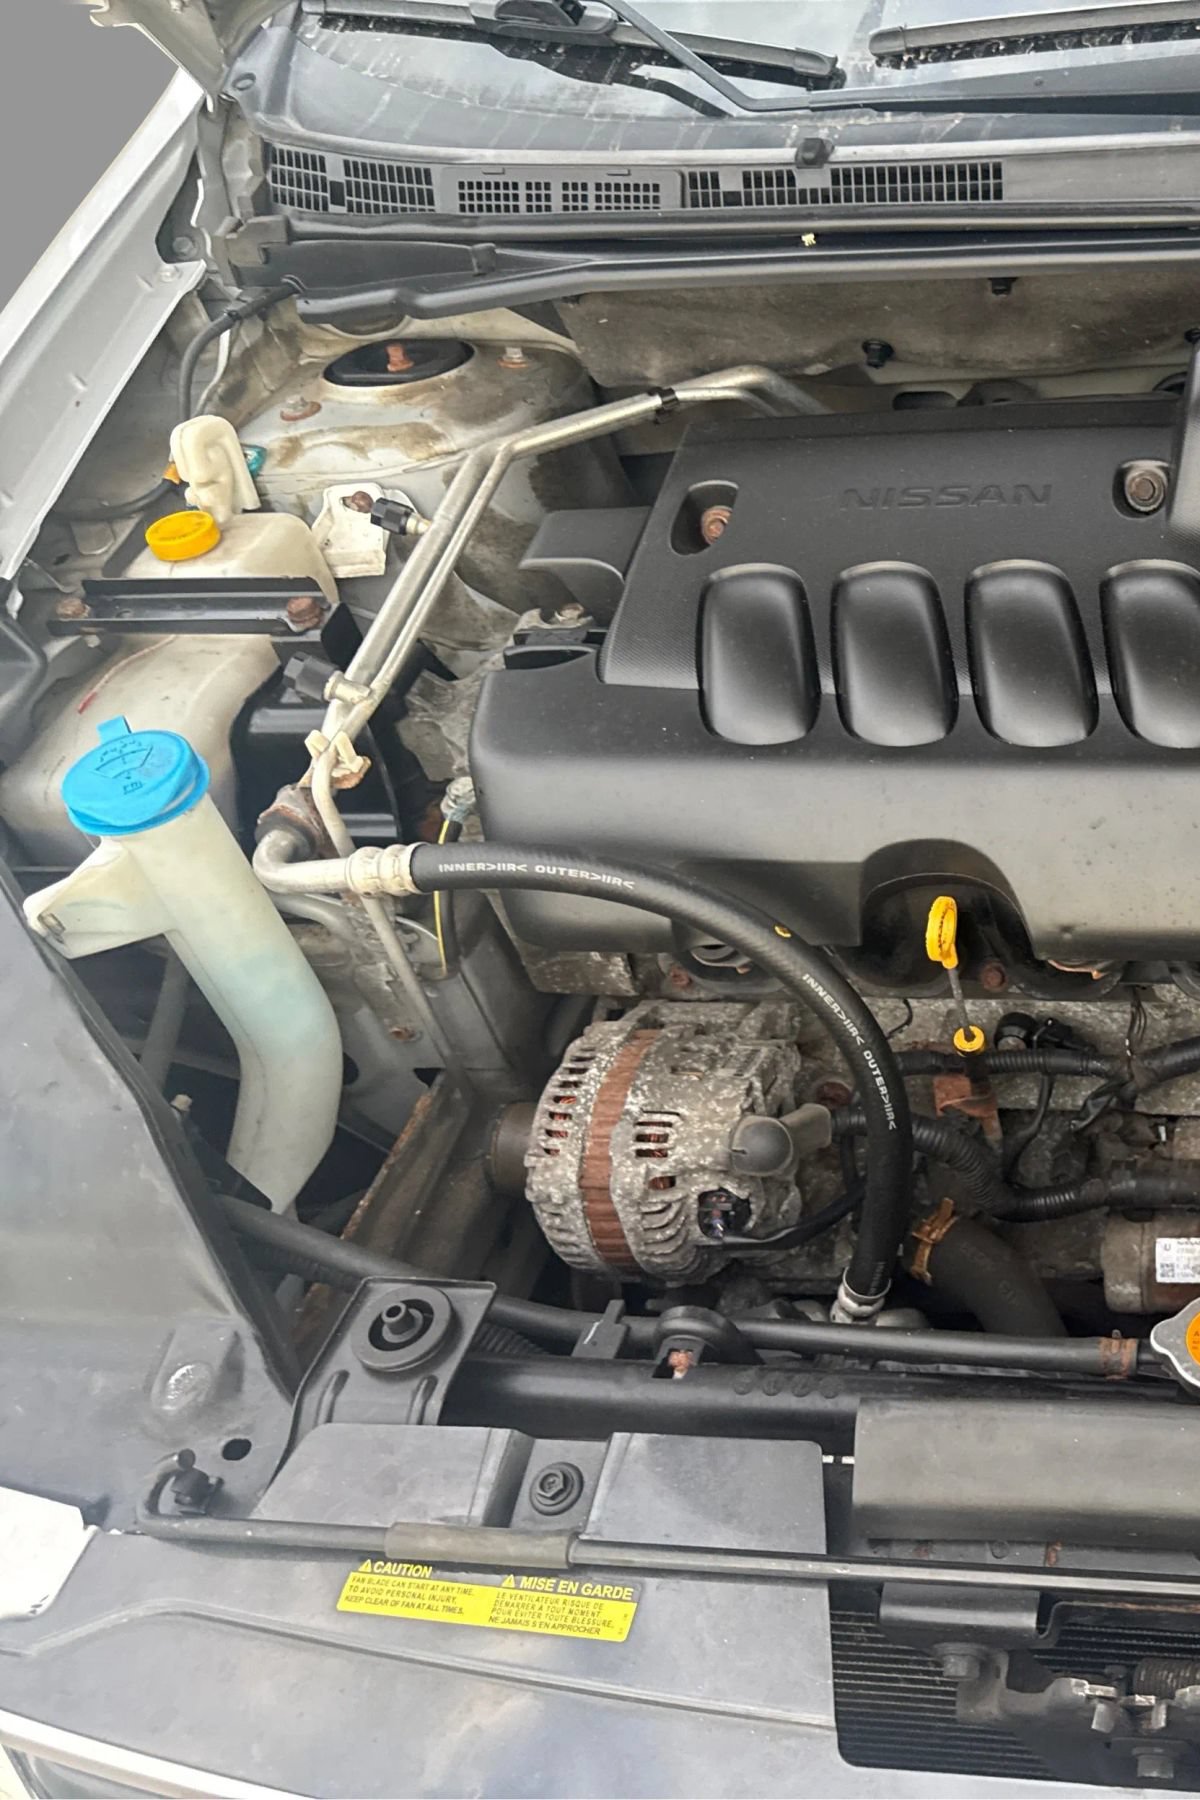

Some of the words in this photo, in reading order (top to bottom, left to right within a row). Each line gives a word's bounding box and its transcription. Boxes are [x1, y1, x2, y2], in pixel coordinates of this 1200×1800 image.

[840, 483, 1052, 511] NISSAN
[373, 1561, 433, 1578] CAUTION
[348, 1585, 359, 1593] TO
[360, 1586, 384, 1596] AVOID
[385, 1589, 426, 1601] PERSONAL
[352, 1575, 366, 1584] FAN
[367, 1577, 390, 1587] BLADE
[391, 1579, 407, 1589] CAN
[407, 1581, 430, 1591] START
[430, 1584, 440, 1592] AT
[441, 1585, 455, 1594] ANY
[519, 1576, 556, 1592] MISE
[557, 1579, 579, 1595] EN
[581, 1583, 634, 1600] GARDE
[344, 1595, 364, 1603] KEEP
[364, 1596, 389, 1606] CLEAR
[389, 1599, 400, 1607] OF
[400, 1600, 416, 1609] FAN
[416, 1602, 427, 1610] AT
[426, 1604, 440, 1612] ALL
[496, 1591, 506, 1599] LE
[509, 1592, 560, 1605] VENTILATEUR
[562, 1598, 591, 1609] RISQUE
[593, 1602, 605, 1610] DE
[491, 1607, 513, 1616] POUR
[545, 1612, 570, 1623] TOUTE
[546, 1605, 566, 1614] TOUT
[488, 1615, 501, 1624] NE
[501, 1617, 530, 1627] JAMAIS
